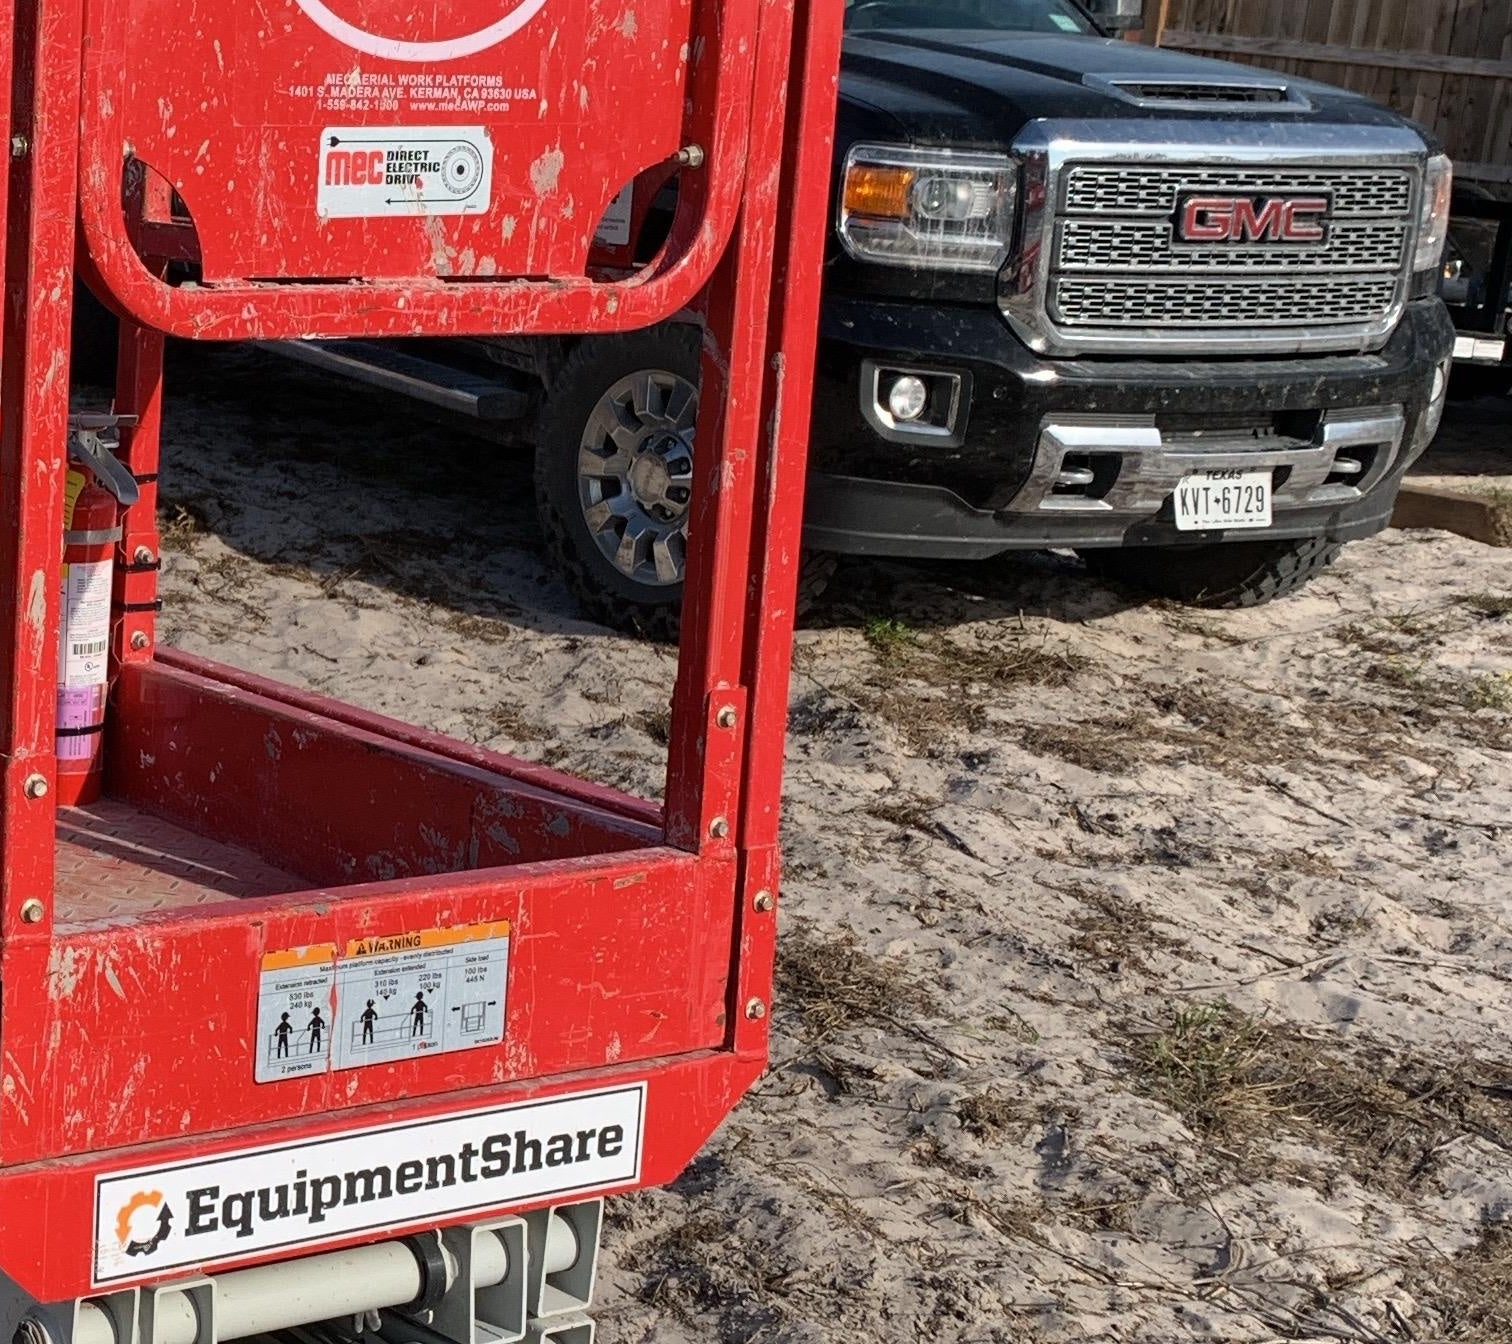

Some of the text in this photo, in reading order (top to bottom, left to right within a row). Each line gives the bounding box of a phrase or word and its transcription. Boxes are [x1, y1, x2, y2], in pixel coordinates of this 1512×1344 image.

[397, 74, 434, 87] WORK
[435, 74, 504, 88] PLATFORMS
[288, 85, 314, 98] 1401
[330, 86, 380, 99] MADERA
[463, 87, 480, 99] CA
[513, 88, 537, 100] USA
[386, 150, 430, 162] DIRECT
[385, 162, 441, 174] ELECTRIC
[1184, 197, 1328, 242] GMC
[1206, 468, 1244, 481] TEXAS
[368, 935, 422, 954] WARNING
[388, 978, 399, 986] lbs
[184, 1122, 625, 1239] EquipmentShare
